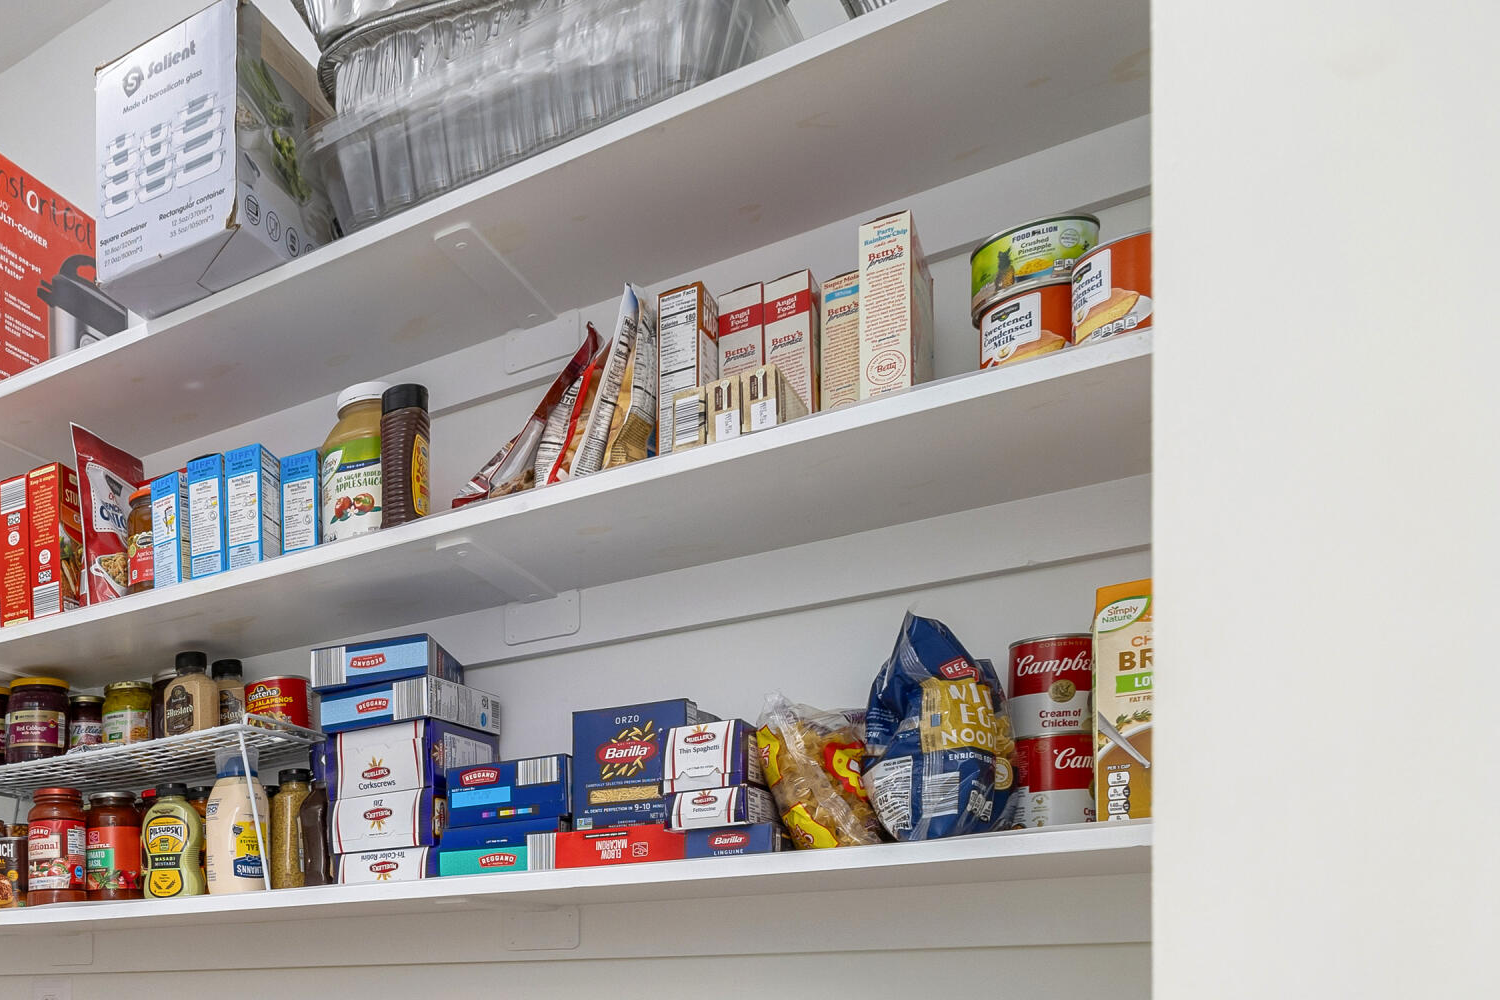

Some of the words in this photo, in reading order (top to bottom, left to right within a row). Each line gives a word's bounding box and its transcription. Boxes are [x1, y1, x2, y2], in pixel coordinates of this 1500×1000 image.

[1012, 231, 1030, 244] FOOD
[1041, 225, 1058, 234] LION
[1020, 236, 1050, 249] Crushed
[868, 244, 904, 262] Betty's
[1018, 242, 1052, 256] Pineapple
[9, 260, 25, 274] made
[19, 255, 41, 275] one-pot
[776, 302, 796, 314] Food
[827, 300, 860, 317] Betty's
[730, 316, 749, 327] Food
[984, 311, 1033, 338] Sweetened
[771, 330, 804, 347] Betty's
[984, 319, 1033, 347] Condensed
[993, 333, 1016, 350] Milk
[724, 343, 756, 359] Betty's
[226, 448, 257, 463] JIFFY
[282, 454, 314, 468] JIFFY
[188, 458, 217, 472] JIFFY
[335, 478, 382, 493] APPLESAUC
[1107, 605, 1138, 617] Simply
[1101, 613, 1132, 624] Nature
[249, 689, 277, 701] Costeña
[1129, 695, 1142, 703] FAT
[255, 696, 294, 708] JALAPEÑOS
[166, 704, 194, 719] Mustard
[1039, 709, 1070, 719] Cream
[1072, 708, 1082, 717] of
[615, 714, 640, 725] ORZO
[1041, 718, 1079, 728] Chicken
[25, 724, 47, 732] Cabbage
[686, 733, 714, 743] MUELLER'S
[605, 745, 649, 760] Barilla
[679, 746, 691, 755] Thin
[692, 744, 720, 754] Spaghetti
[1116, 773, 1122, 781] 5
[358, 780, 396, 790] Corkscrews
[634, 803, 651, 811] 9-10
[149, 826, 183, 840] PILSUDSKI
[595, 838, 628, 851] MACARONI
[714, 835, 744, 845] Barilla
[361, 853, 378, 861] Rotini
[379, 851, 405, 859] Tri-Color
[601, 848, 622, 860] ELBOW
[713, 848, 744, 856] LINGUINE
